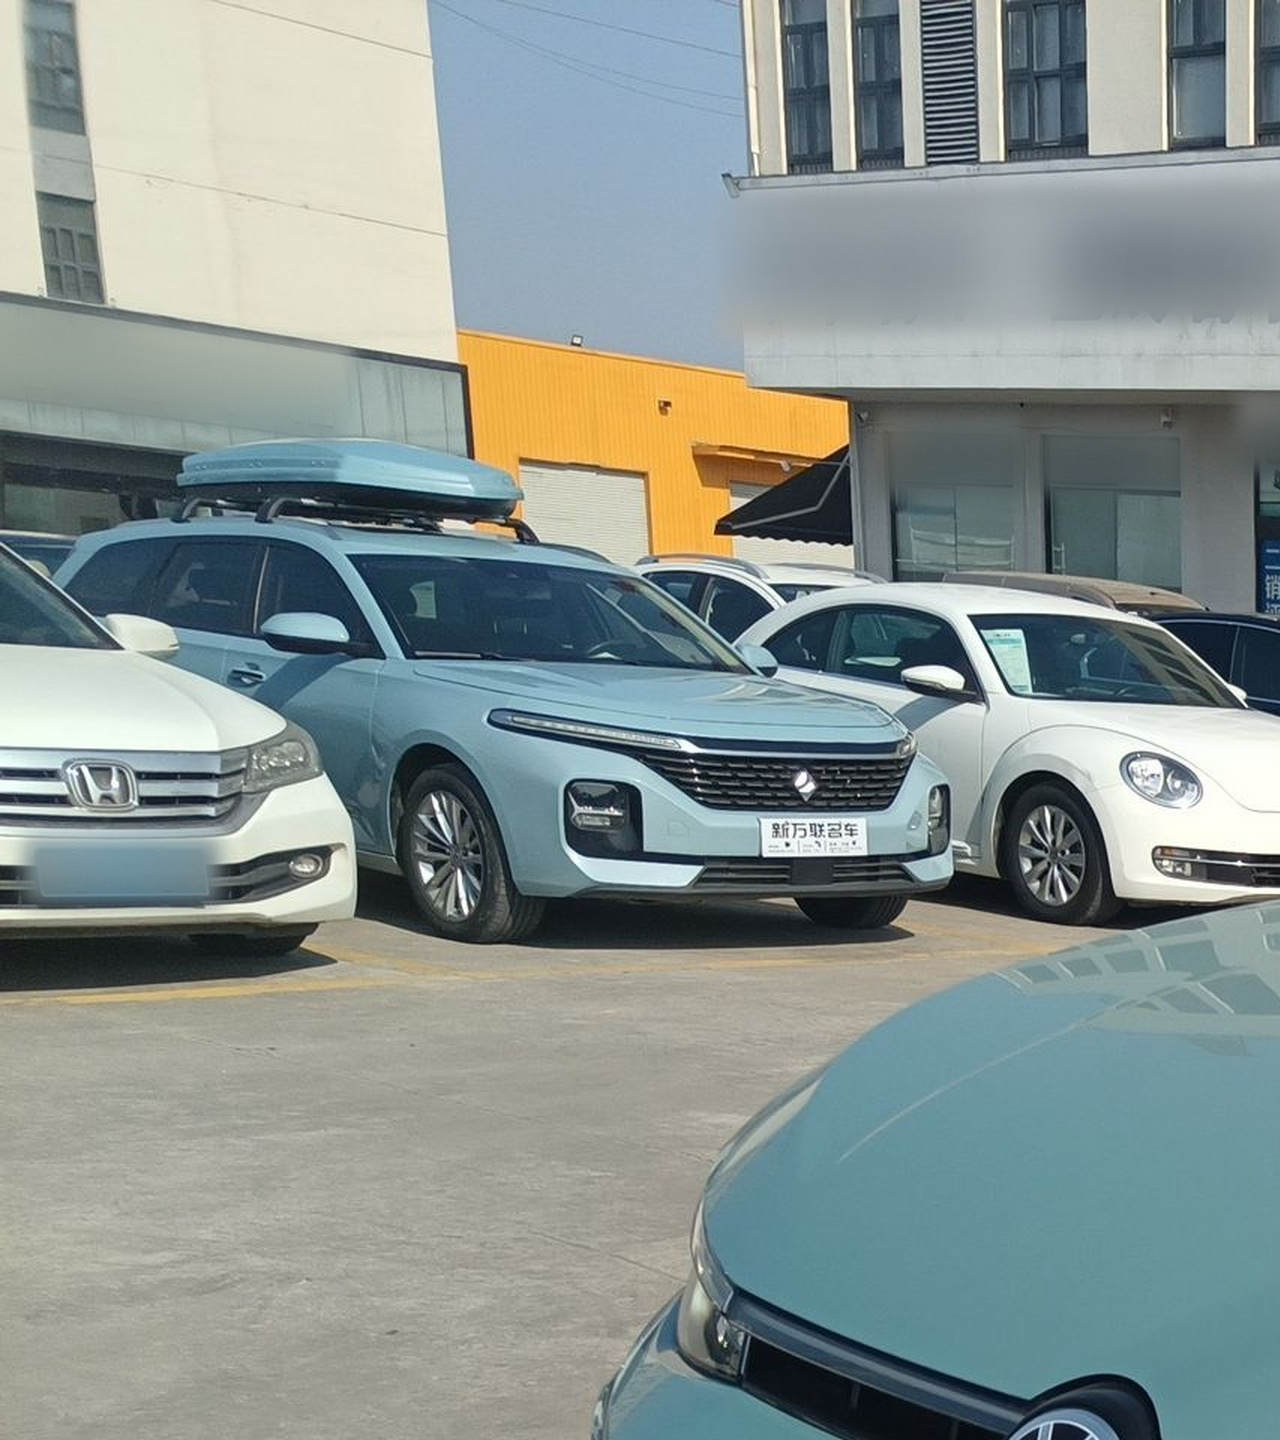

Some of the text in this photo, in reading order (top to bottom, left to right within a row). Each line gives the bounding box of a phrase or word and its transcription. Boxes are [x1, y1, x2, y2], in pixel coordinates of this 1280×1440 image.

[771, 820, 859, 839] 新万联名车
